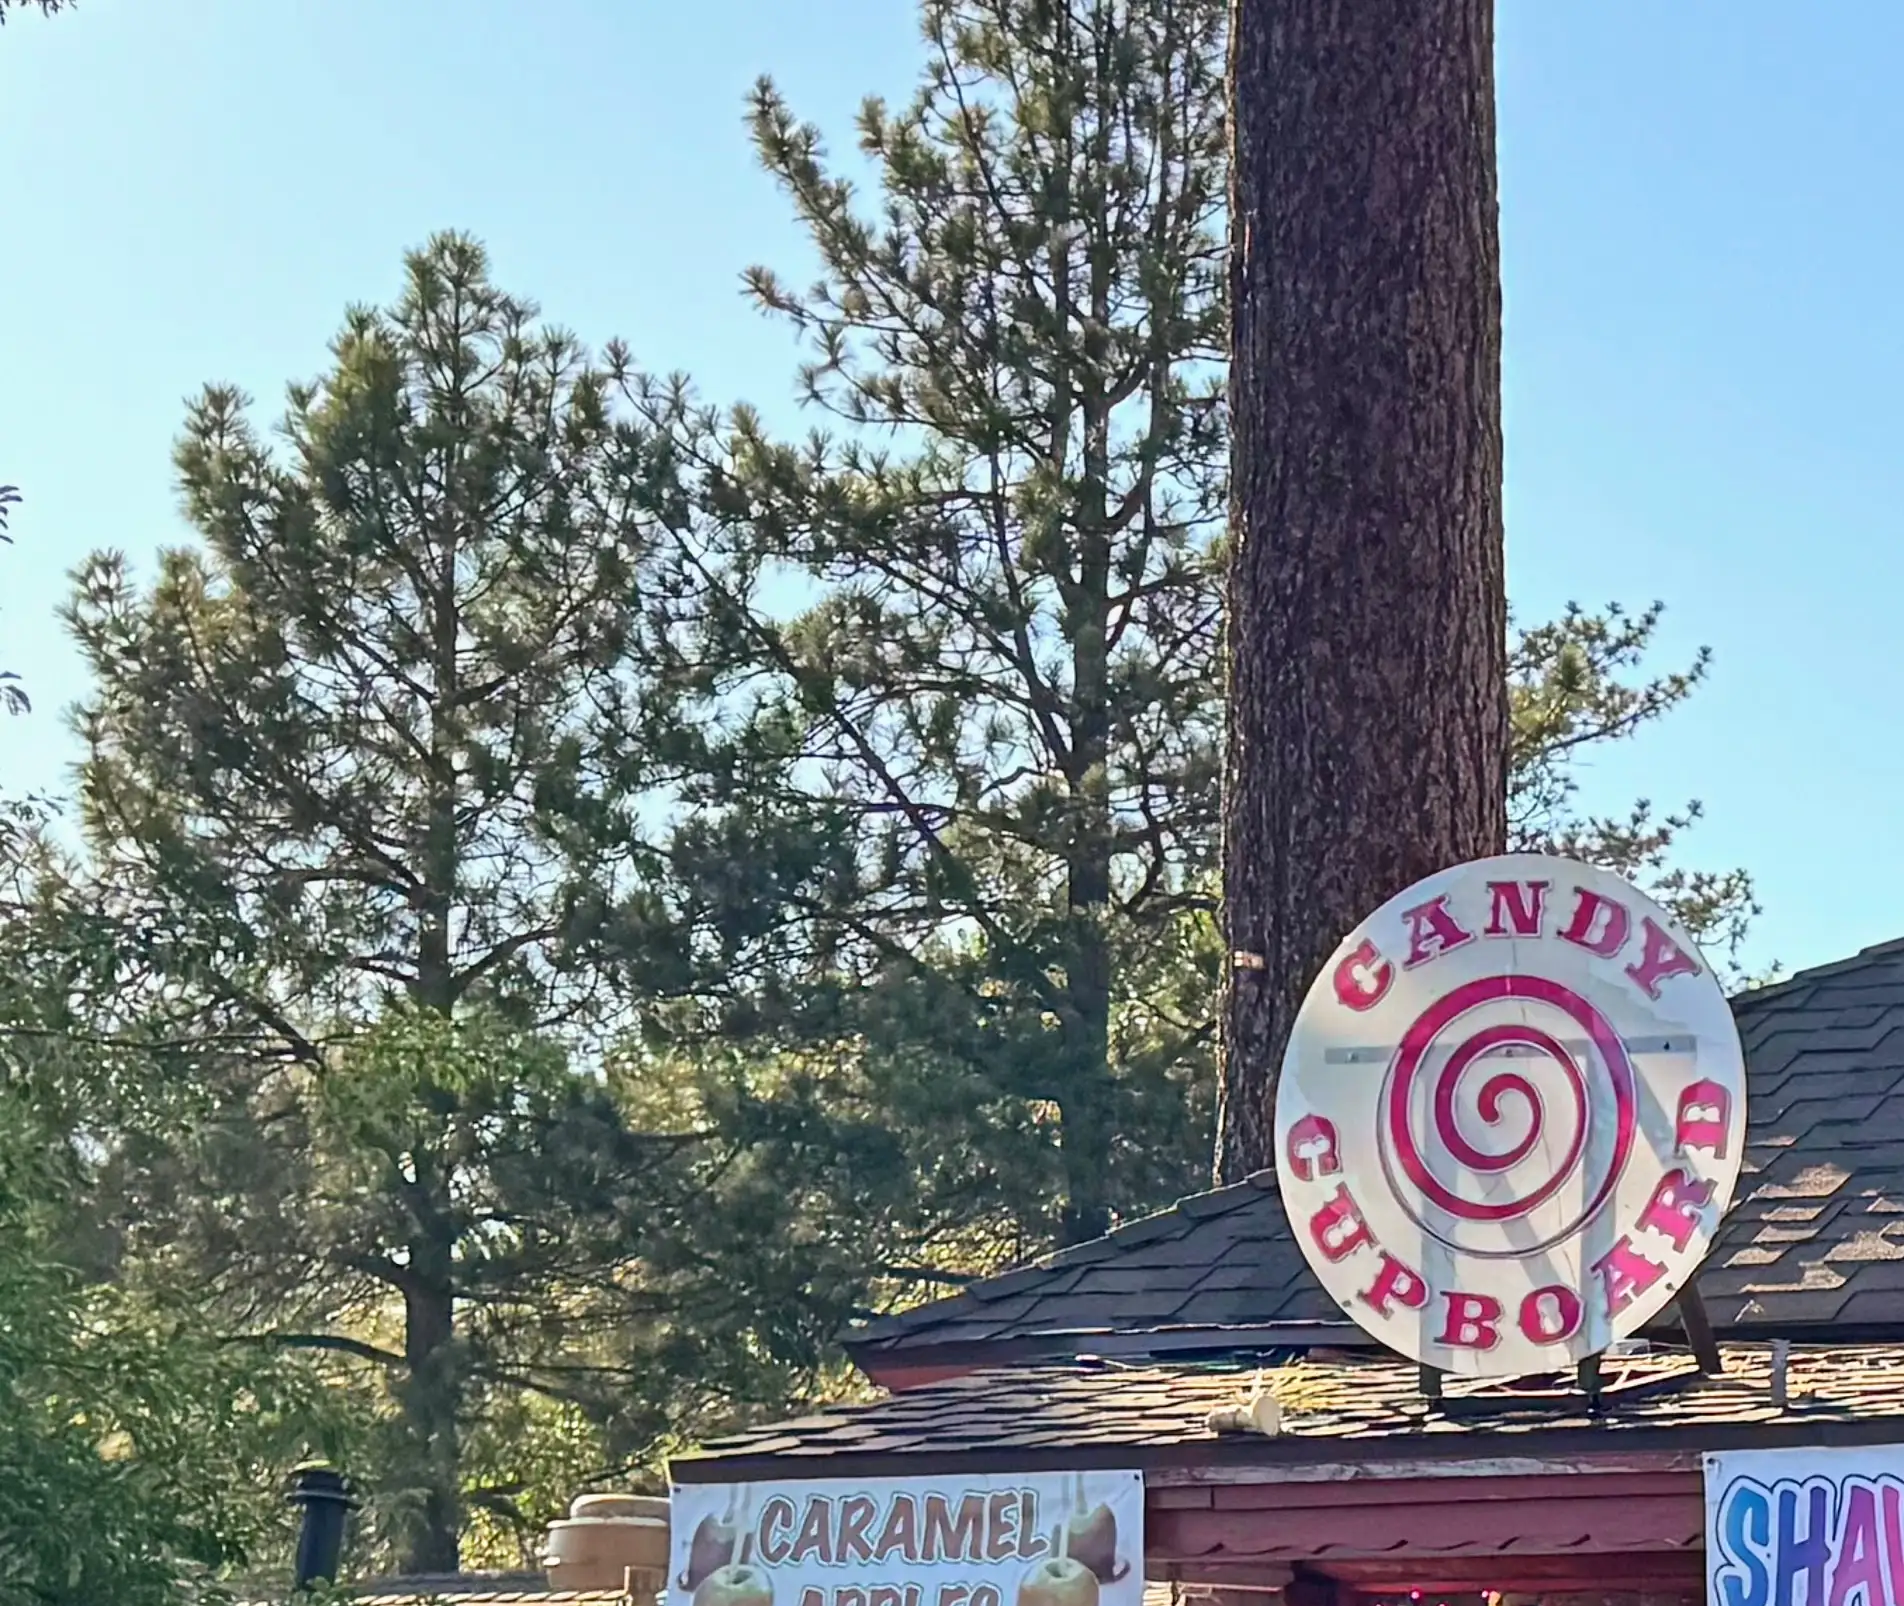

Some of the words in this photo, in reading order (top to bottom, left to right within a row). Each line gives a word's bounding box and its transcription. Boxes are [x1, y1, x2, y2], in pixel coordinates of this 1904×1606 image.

[1333, 879, 1701, 1012] CANDY
[1287, 1078, 1732, 1350] CUPBOARD
[757, 1489, 1051, 1565] CARAMEL
